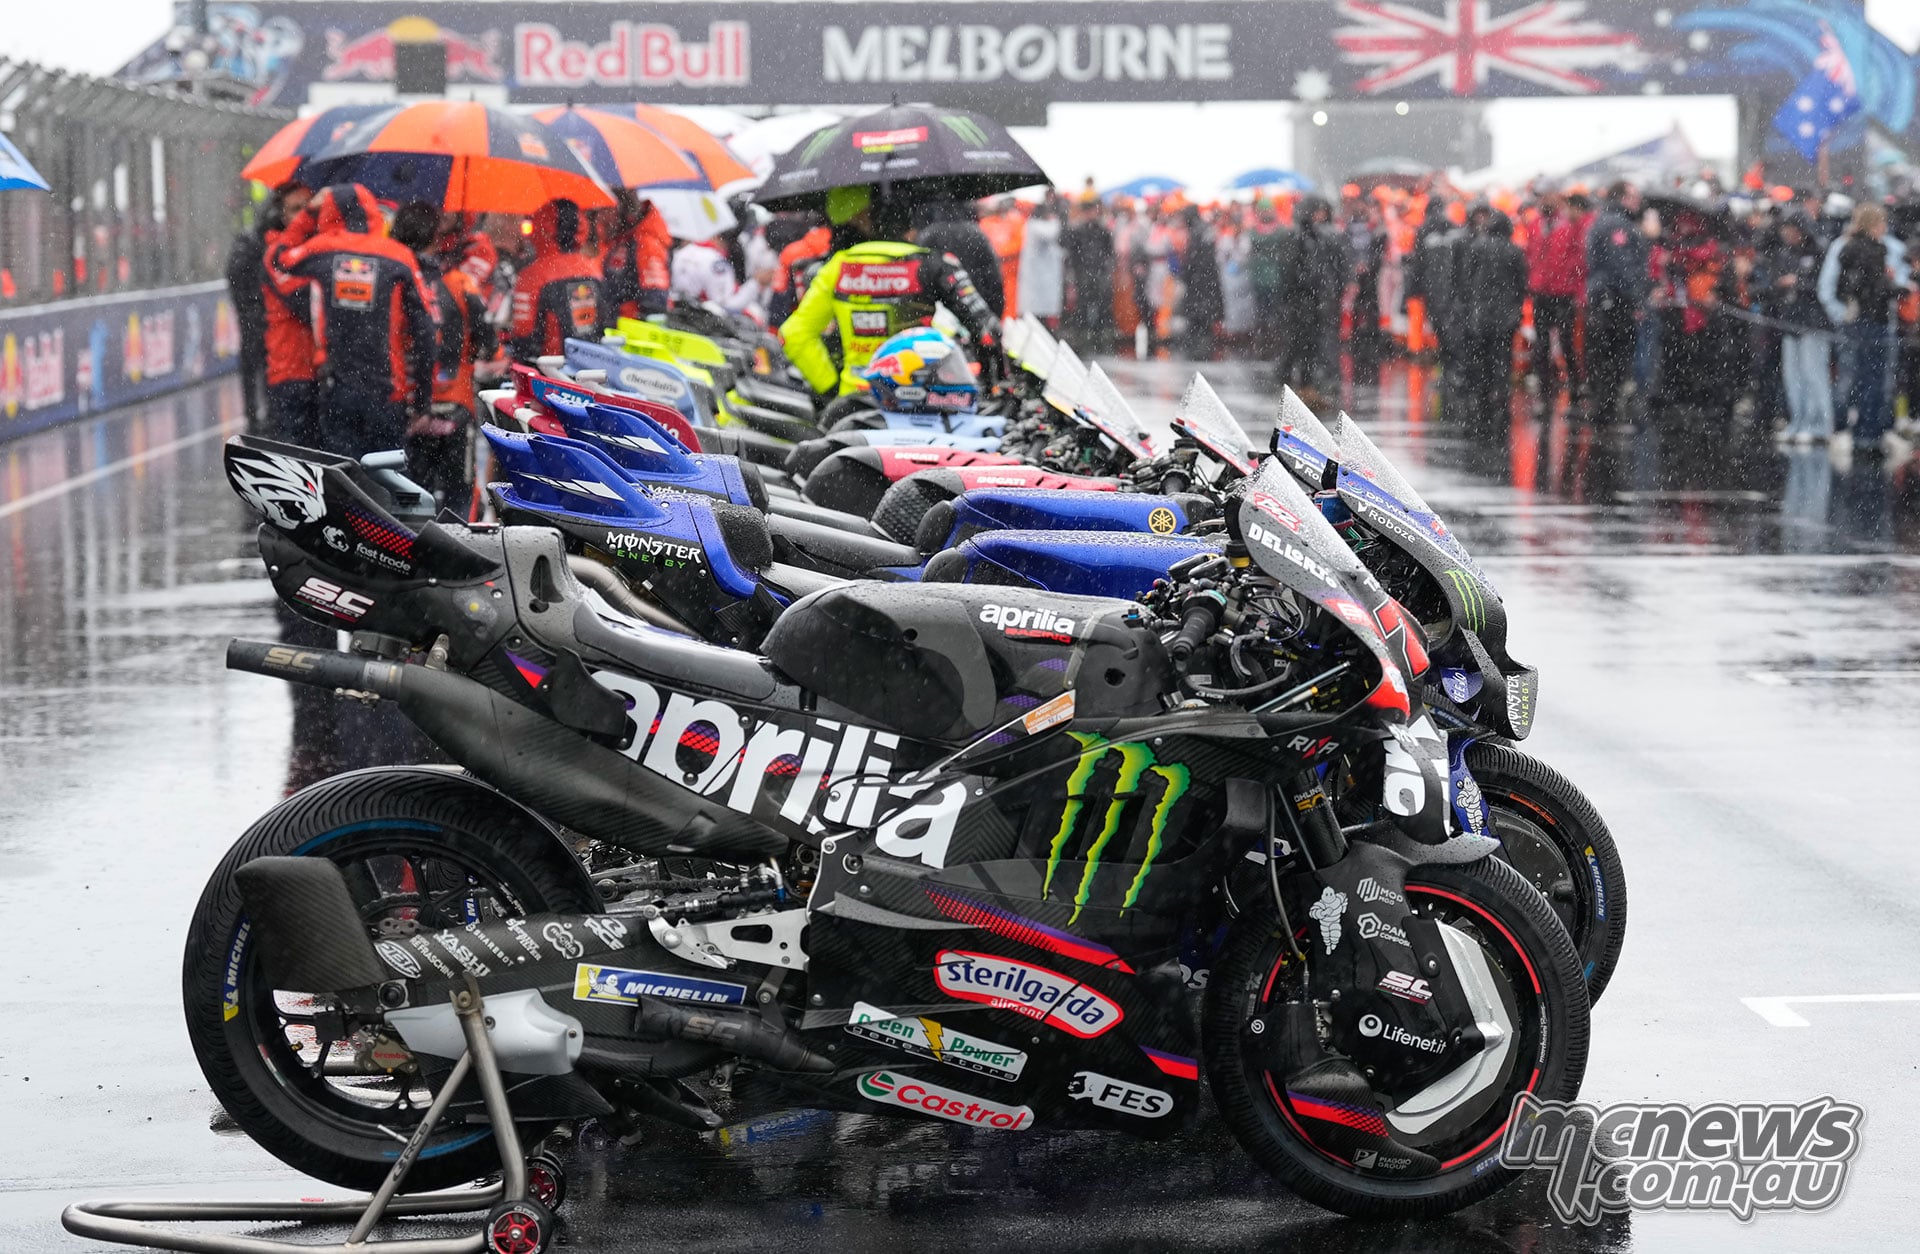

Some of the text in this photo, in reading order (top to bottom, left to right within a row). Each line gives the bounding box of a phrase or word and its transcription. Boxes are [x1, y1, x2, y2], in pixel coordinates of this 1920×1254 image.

[514, 21, 750, 87] Red Bull
[823, 23, 1233, 82] MELBOURNE
[894, 452, 940, 461] DUCATI
[976, 476, 1026, 485] DUCATI
[1368, 508, 1417, 543] Roboze
[356, 542, 378, 559] fast
[379, 552, 411, 571] trade
[299, 576, 376, 616] SC
[979, 603, 1076, 636] aprilia
[263, 646, 323, 670] SC
[1521, 682, 1529, 726] ENERGY
[590, 669, 968, 870] aprilia
[1592, 864, 1606, 917] MICHELIN
[1382, 923, 1407, 939] PAN
[226, 922, 251, 986] MICHEL
[439, 929, 491, 977] YASHI
[623, 980, 730, 1004] MICHELIN
[947, 961, 1105, 1025] sterilgarda
[1378, 981, 1431, 1000] PROJECT
[1382, 970, 1433, 997] SC
[683, 1016, 742, 1040] SC
[1382, 1021, 1448, 1056] Lifenet.it
[950, 1036, 1015, 1068] Power
[896, 1083, 1027, 1131] Castrol
[1100, 1084, 1166, 1115] FES
[1377, 1162, 1407, 1170] GROUP
[1379, 1156, 1412, 1165] PIAGGIO
